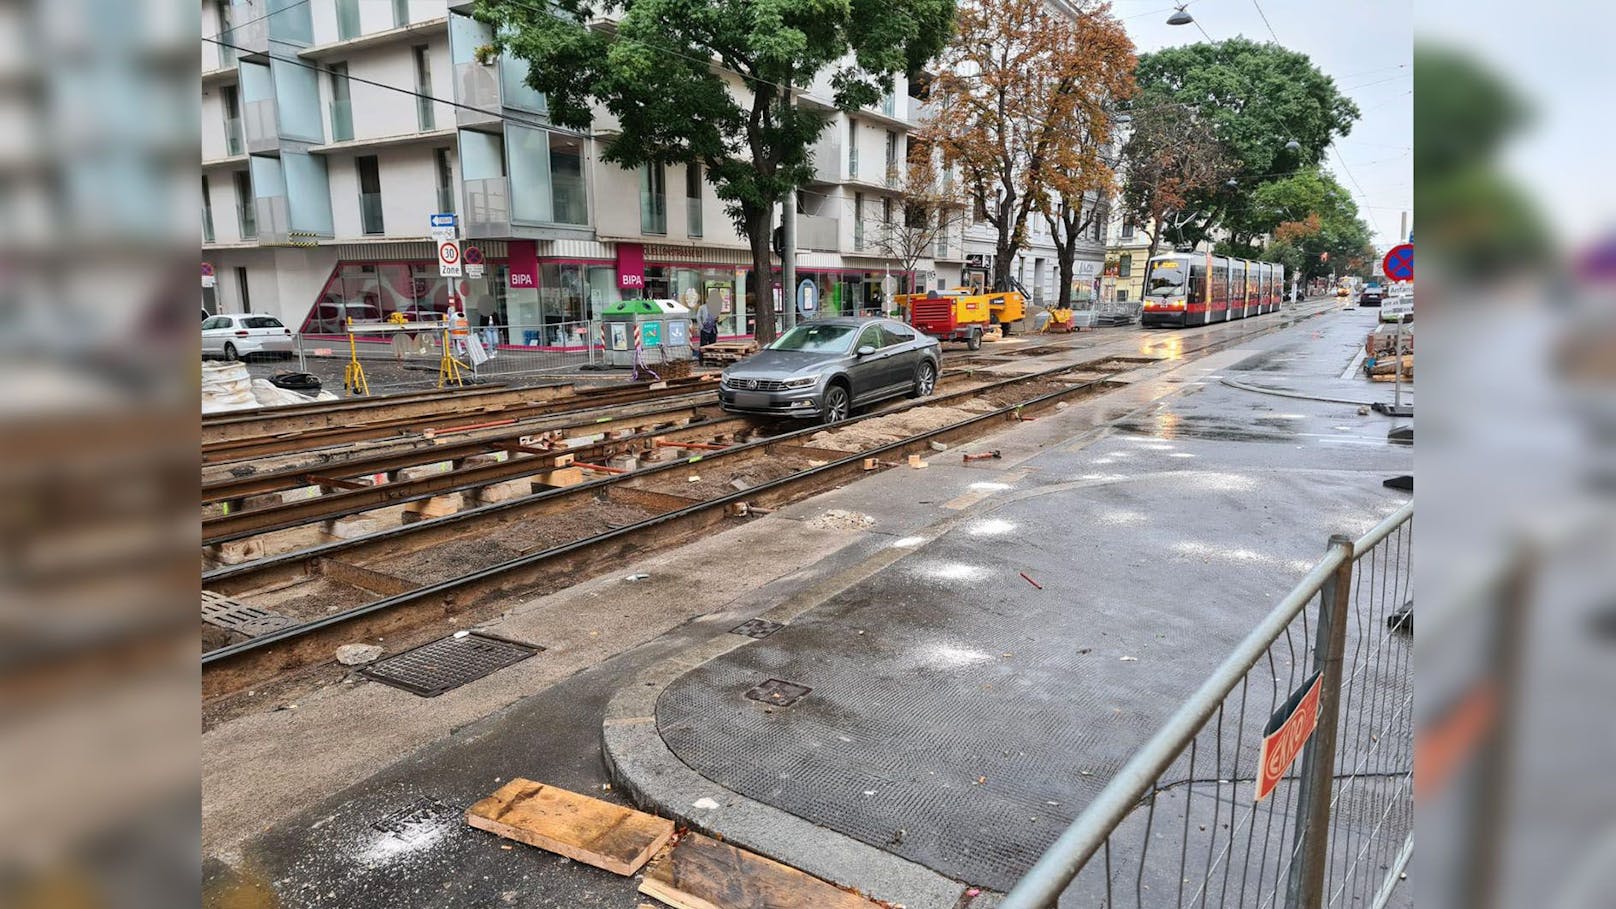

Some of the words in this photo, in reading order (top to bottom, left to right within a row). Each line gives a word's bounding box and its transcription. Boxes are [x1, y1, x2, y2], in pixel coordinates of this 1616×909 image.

[444, 248, 455, 259] 30
[442, 265, 459, 275] Zone
[511, 274, 533, 285] BIPA
[622, 274, 643, 285] BIPA
